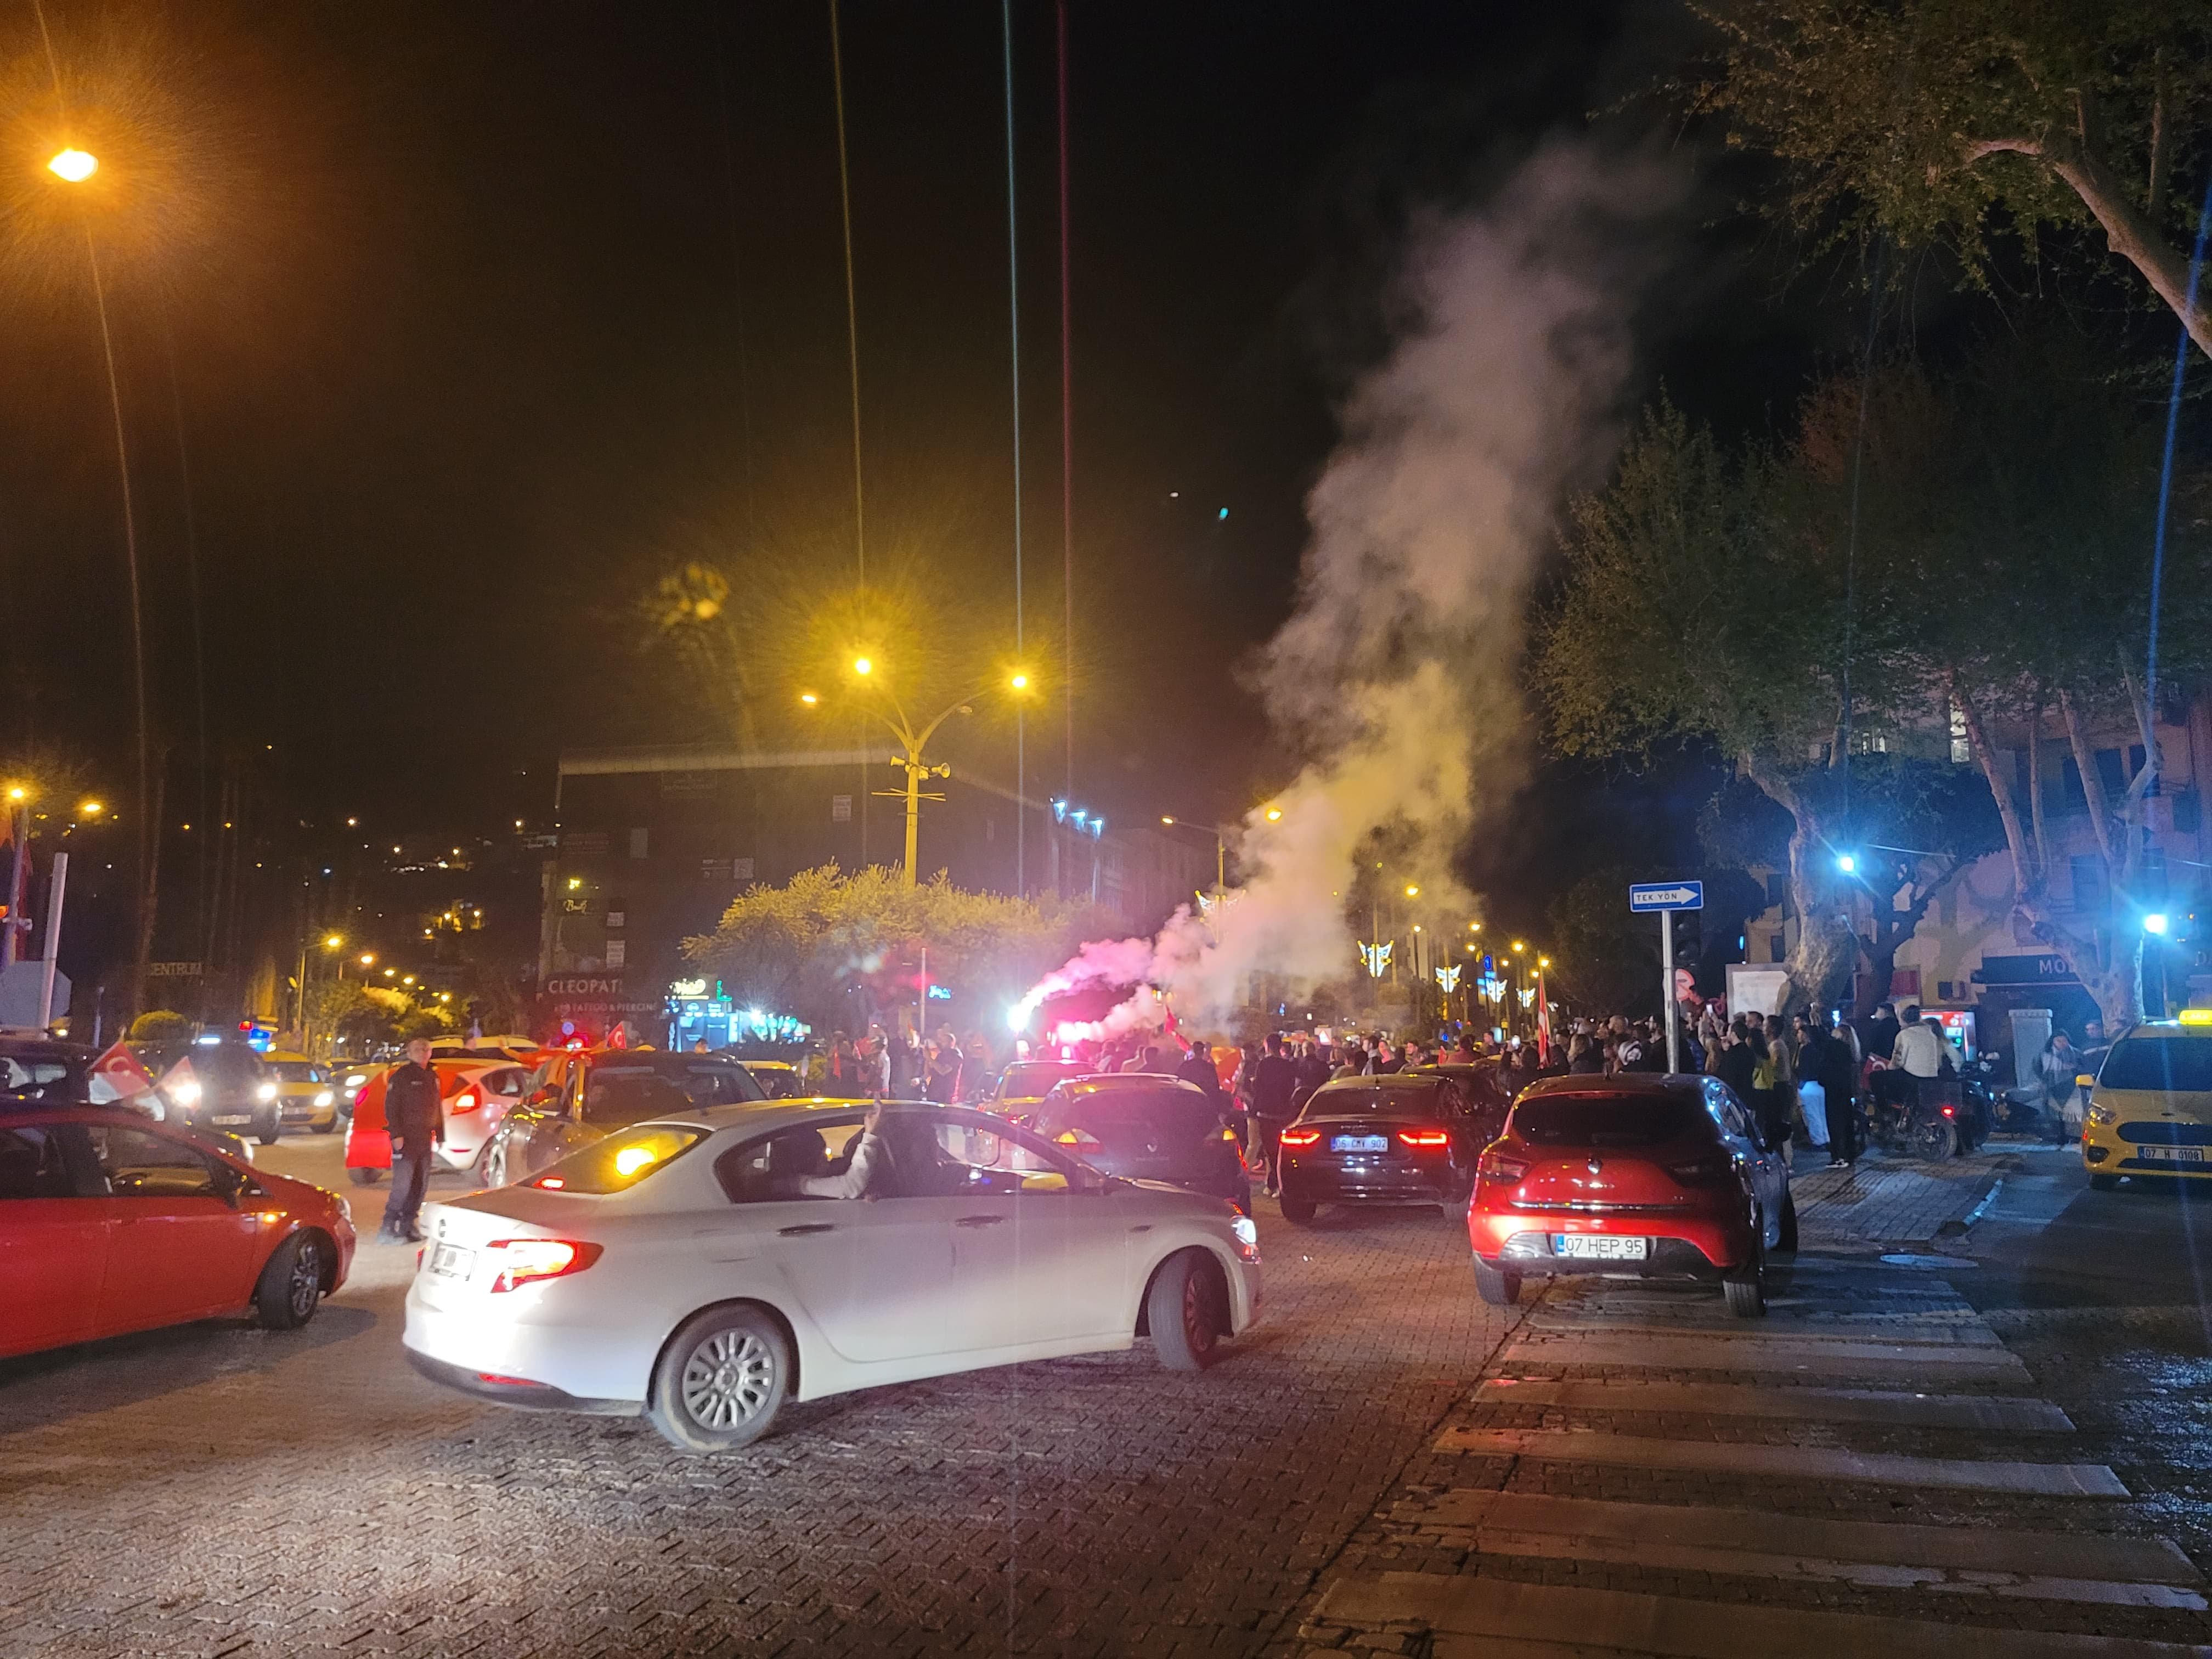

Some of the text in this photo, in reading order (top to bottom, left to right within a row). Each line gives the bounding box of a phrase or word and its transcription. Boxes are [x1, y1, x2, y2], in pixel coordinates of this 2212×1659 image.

[2039, 958, 2075, 974] MO
[2146, 1149, 2156, 1158] 07
[2164, 1150, 2170, 1159] H
[1565, 1238, 1643, 1253] 07 HEP 95
